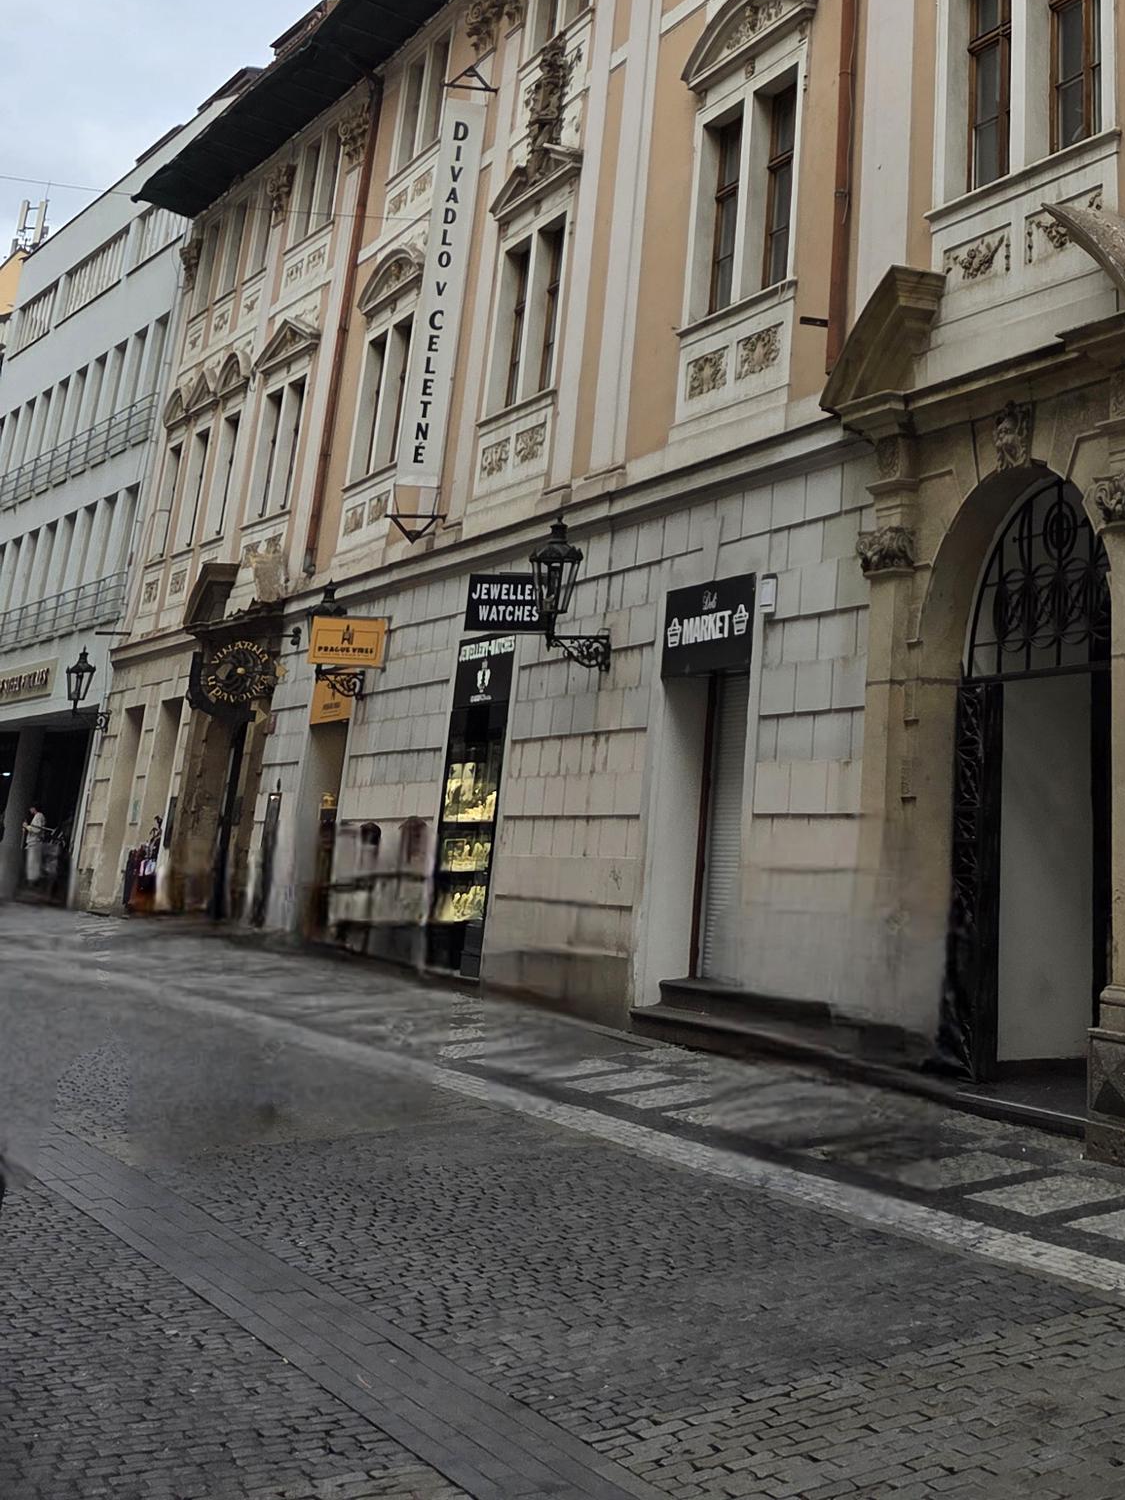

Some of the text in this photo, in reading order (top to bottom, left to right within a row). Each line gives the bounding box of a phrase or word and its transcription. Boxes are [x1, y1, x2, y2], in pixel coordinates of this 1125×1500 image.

[412, 120, 469, 464] DIVADLO V CELETNÉ
[471, 583, 549, 601] JEWELLEY
[478, 605, 540, 622] WATCHES
[682, 610, 733, 645] MARKET
